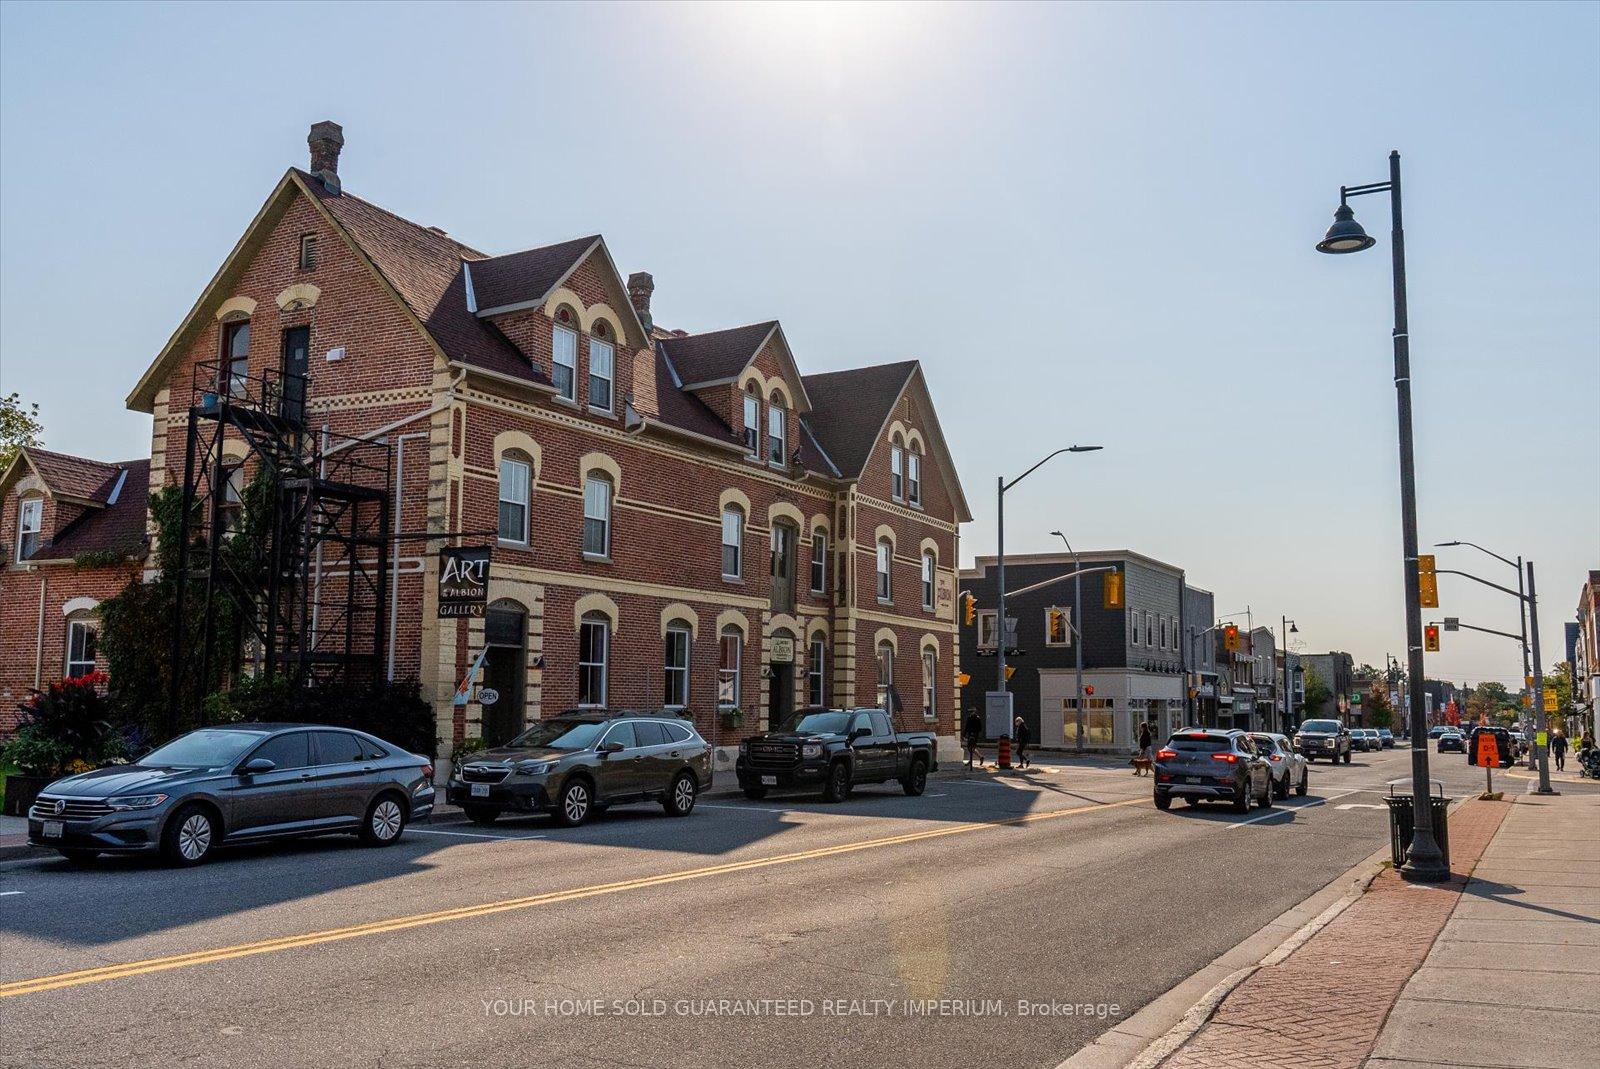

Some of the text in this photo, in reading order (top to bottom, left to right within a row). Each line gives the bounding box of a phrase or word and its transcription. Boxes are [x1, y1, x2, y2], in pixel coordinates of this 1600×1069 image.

[440, 557, 489, 585] ART
[440, 604, 485, 616] GALLERY
[479, 692, 497, 701] OPEN
